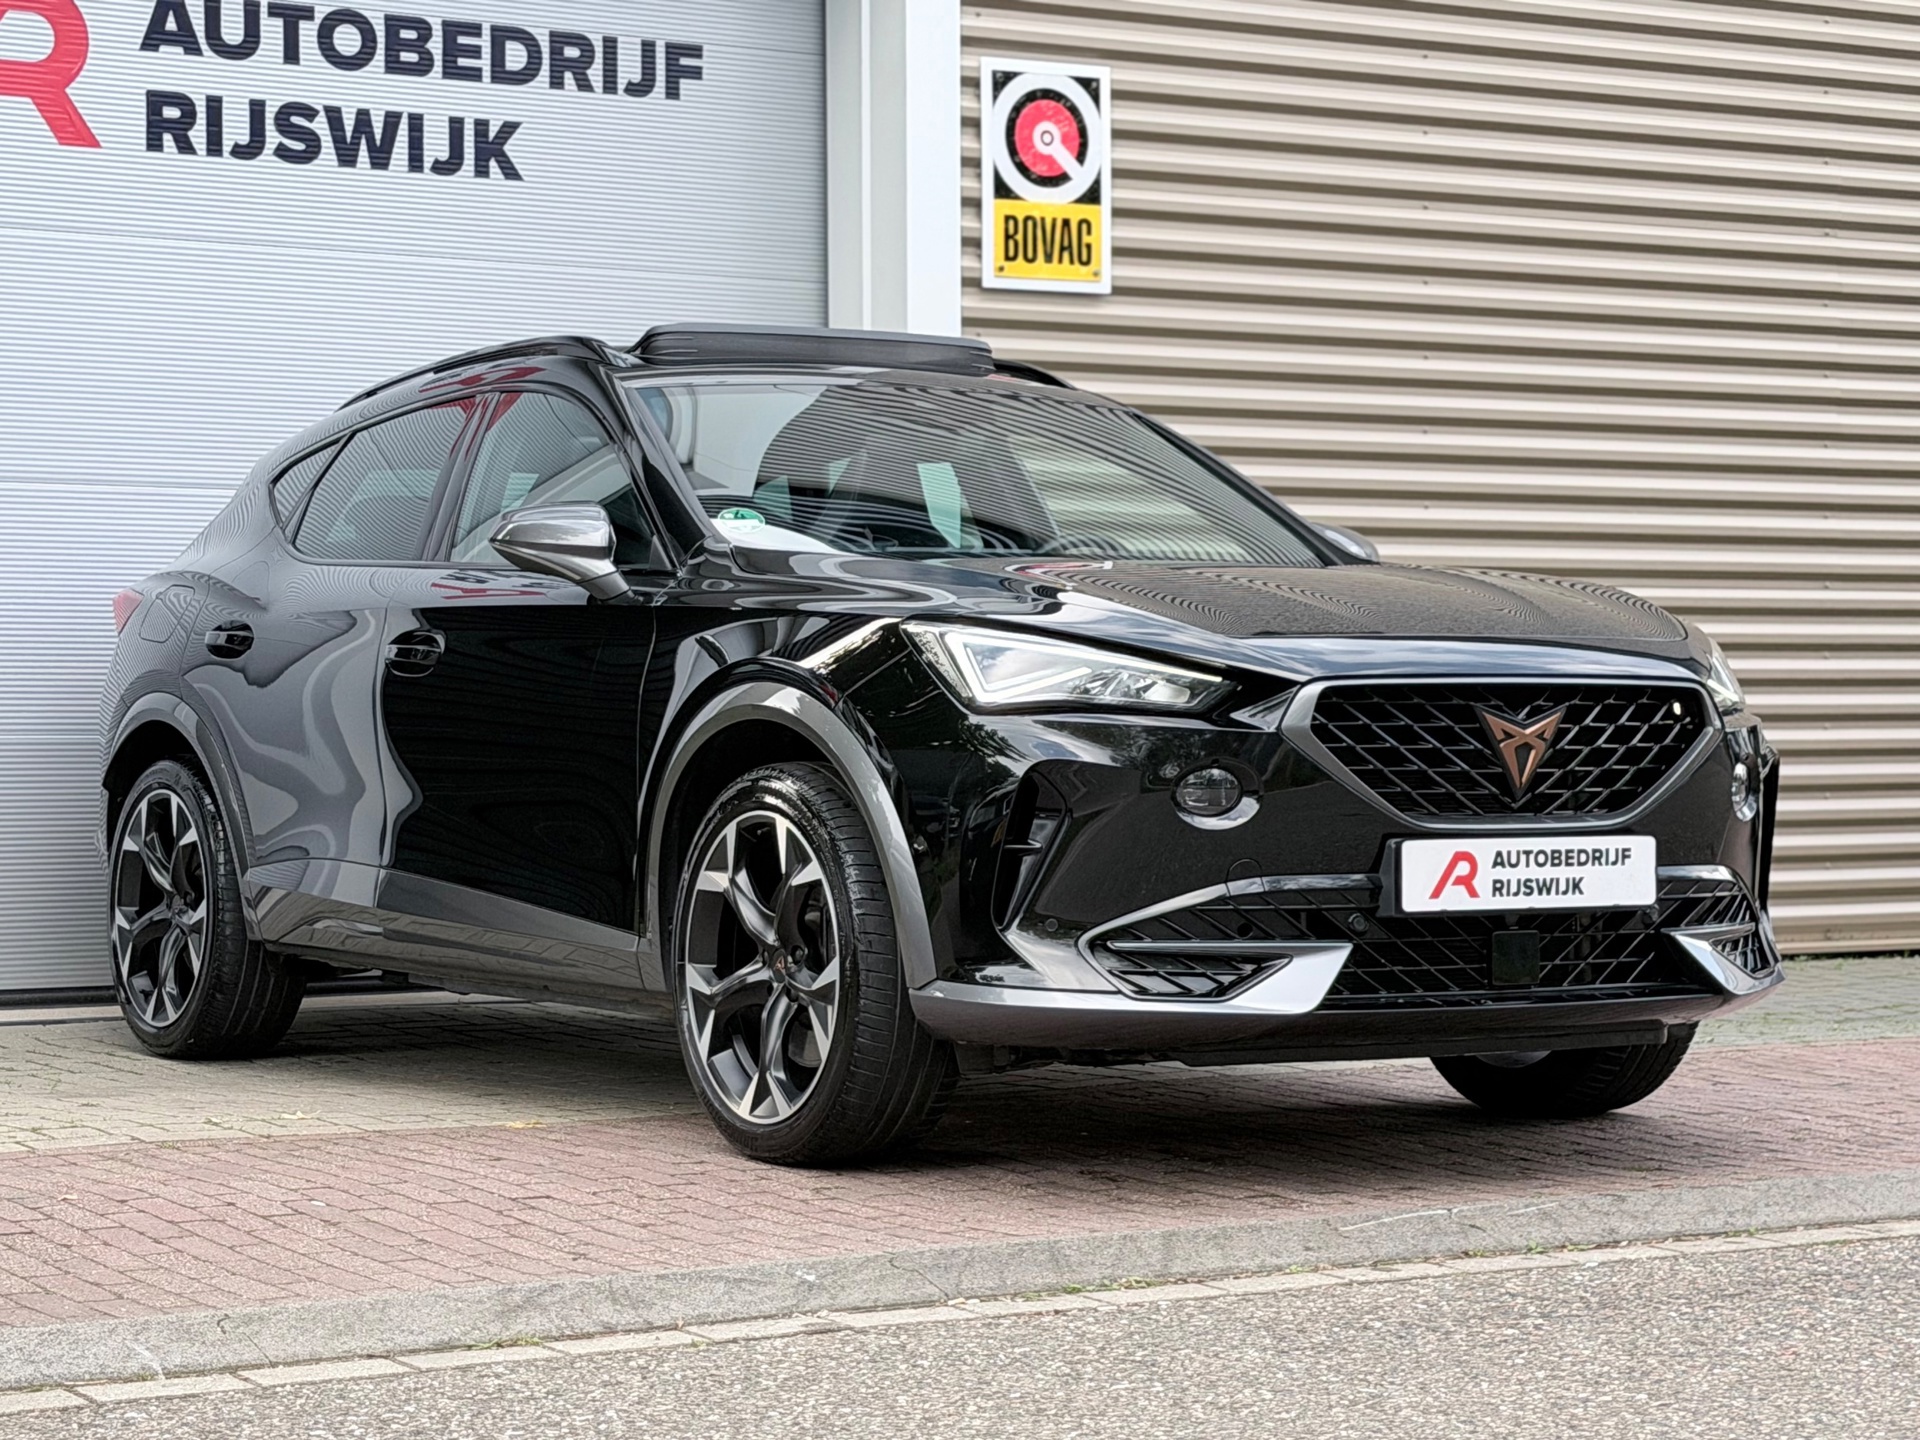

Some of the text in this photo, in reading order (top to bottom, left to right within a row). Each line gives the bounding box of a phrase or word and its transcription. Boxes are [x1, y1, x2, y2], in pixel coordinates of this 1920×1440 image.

[139, 0, 703, 101] AUTOBEDRIJF
[145, 89, 523, 181] RIJSWIJK
[1003, 214, 1093, 266] BOVAG
[1491, 847, 1632, 869] AUTOBEDRIJF
[1491, 876, 1585, 898] RIJSWIJK
